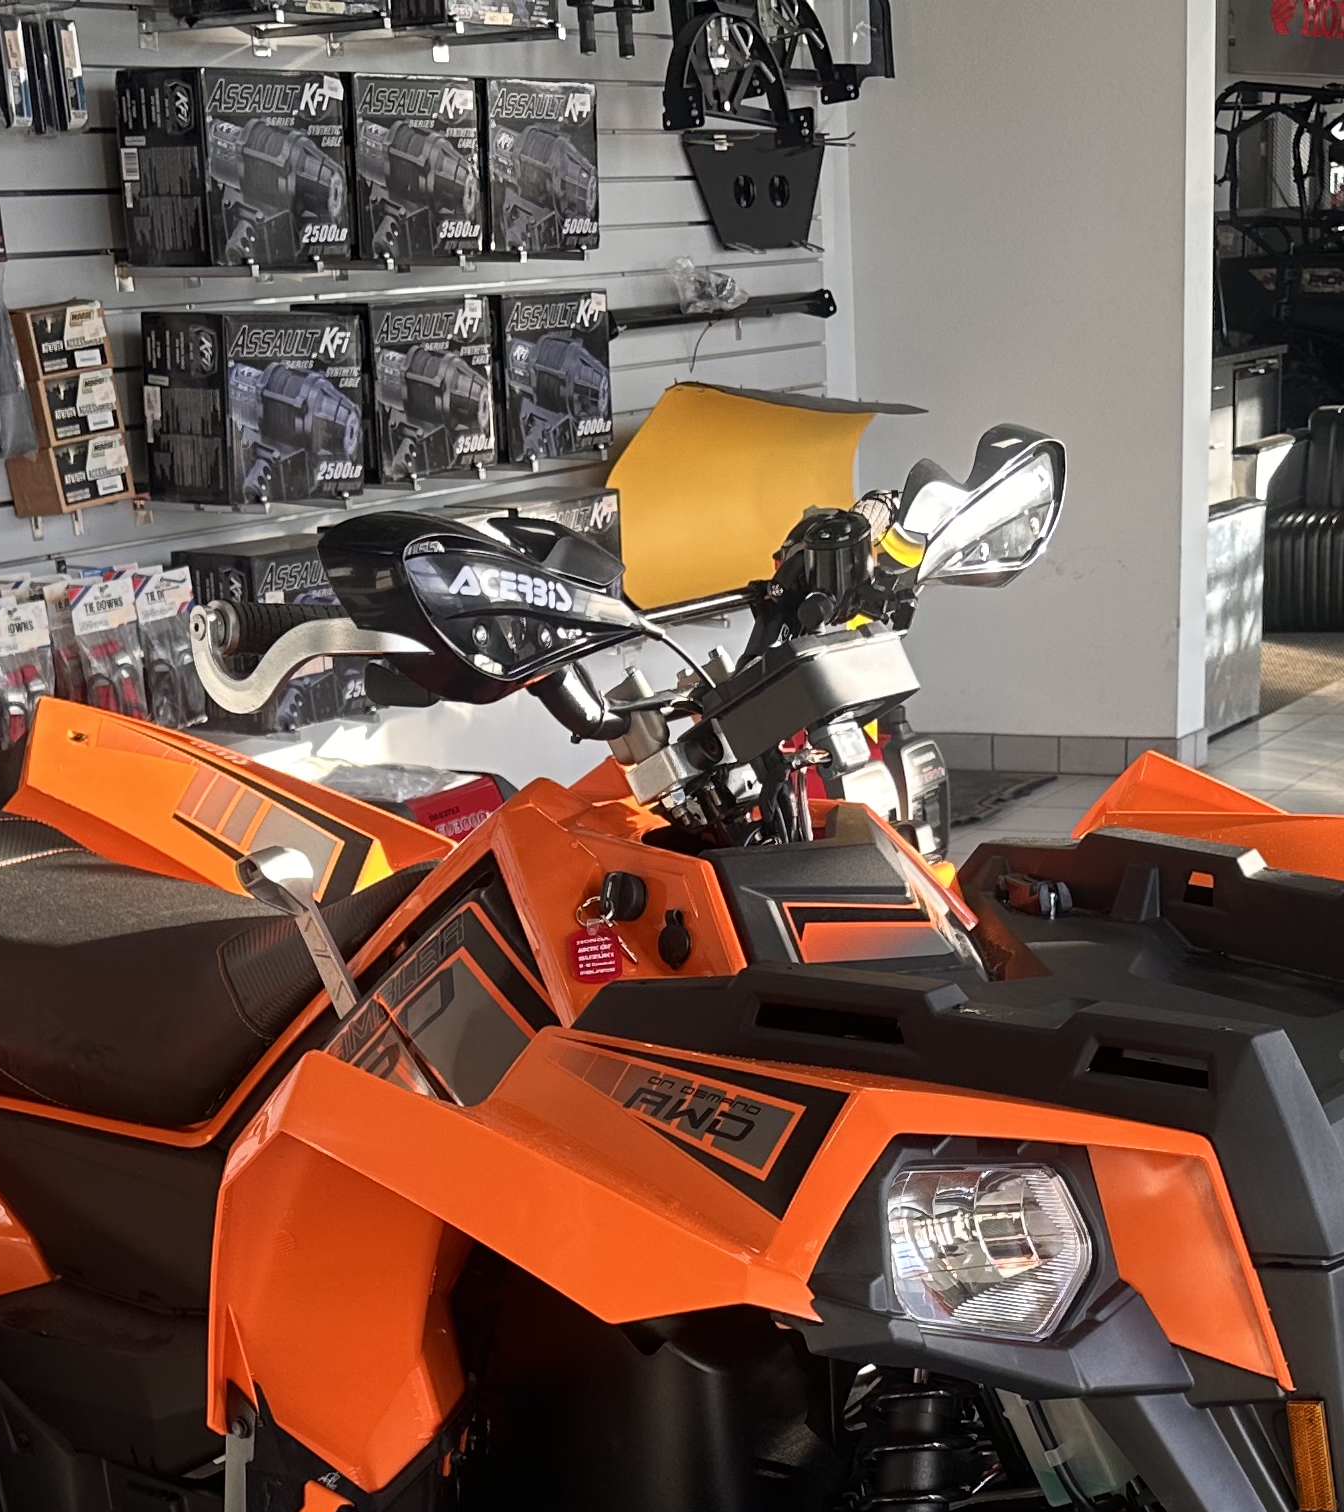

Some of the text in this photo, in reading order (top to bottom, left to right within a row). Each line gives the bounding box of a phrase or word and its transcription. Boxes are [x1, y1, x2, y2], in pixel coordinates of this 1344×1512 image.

[207, 78, 300, 113] ASSAULT
[358, 83, 440, 115] ASSAULT
[489, 88, 566, 119] ASSAULT
[265, 116, 296, 127] SERIES
[302, 223, 348, 244] 2500LB
[440, 220, 480, 239] 3500LB
[562, 218, 598, 236] 5000LB
[376, 312, 454, 343] ASSAULT
[507, 301, 577, 332] ASSAULT
[228, 325, 352, 359] ASSAULT KFi
[577, 418, 612, 437] 5000LB
[456, 433, 494, 454] 3500LB
[316, 461, 362, 481] 2500LB
[258, 560, 329, 597] ASSAU
[448, 565, 573, 612] ACERBIS
[647, 1075, 762, 1115] ON DEMAND
[622, 1087, 755, 1142] AWD
